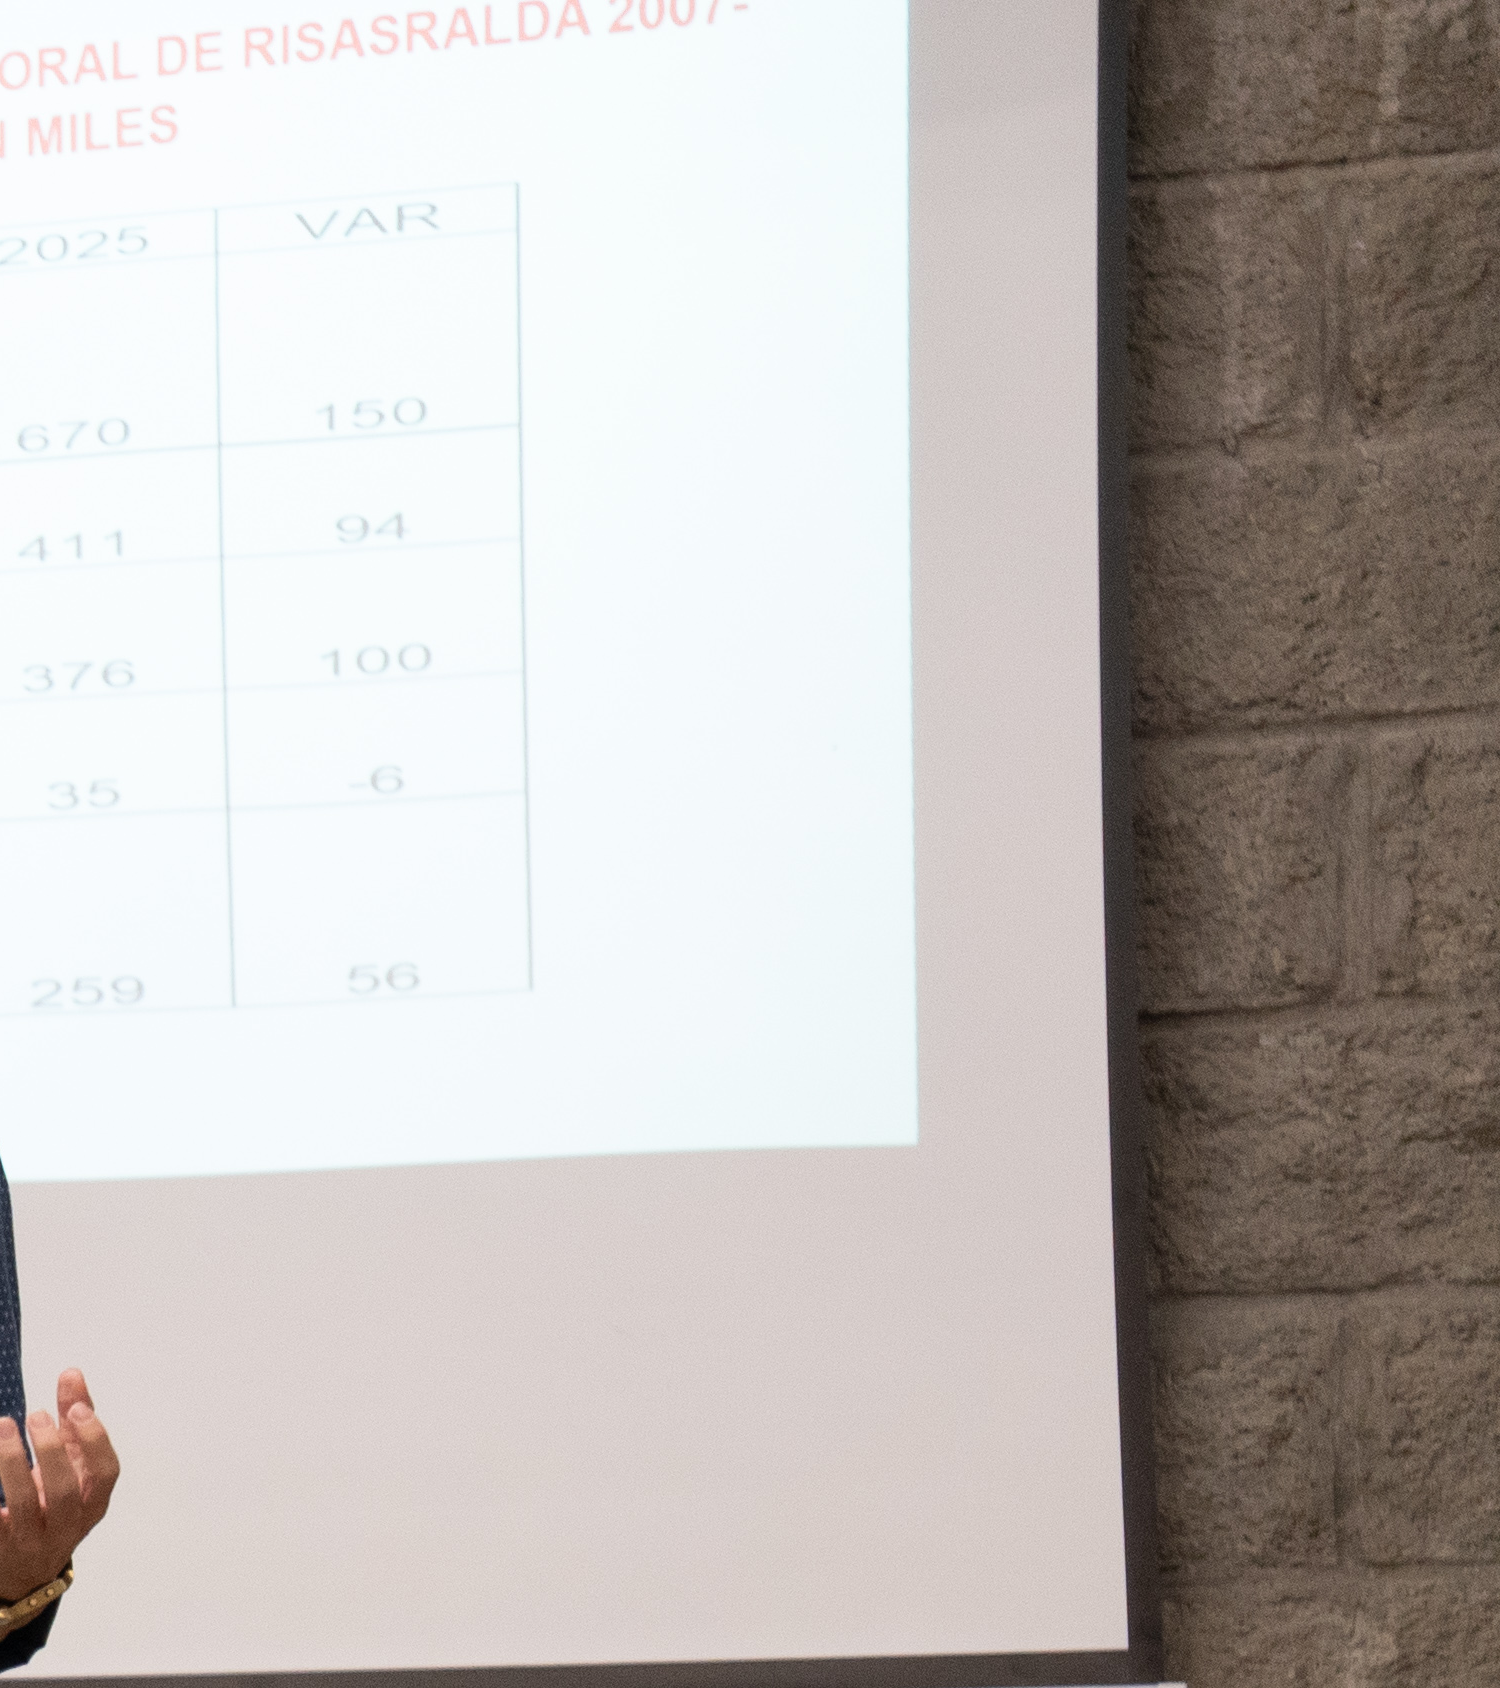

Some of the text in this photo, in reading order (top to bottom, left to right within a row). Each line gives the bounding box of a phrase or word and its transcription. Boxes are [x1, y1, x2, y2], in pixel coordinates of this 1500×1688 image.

[156, 30, 224, 79] DE
[244, 0, 591, 70] RISASRALDA
[26, 103, 179, 157] MILES
[294, 201, 442, 241] VAR
[314, 396, 428, 434] 150
[15, 417, 132, 455] 670
[17, 529, 125, 563] 411
[334, 511, 409, 545] 94
[22, 658, 137, 695] 376
[319, 642, 434, 678] 100
[46, 778, 122, 812] 35
[347, 764, 406, 796] -6
[29, 974, 147, 1011] 259
[346, 962, 422, 995] 56
